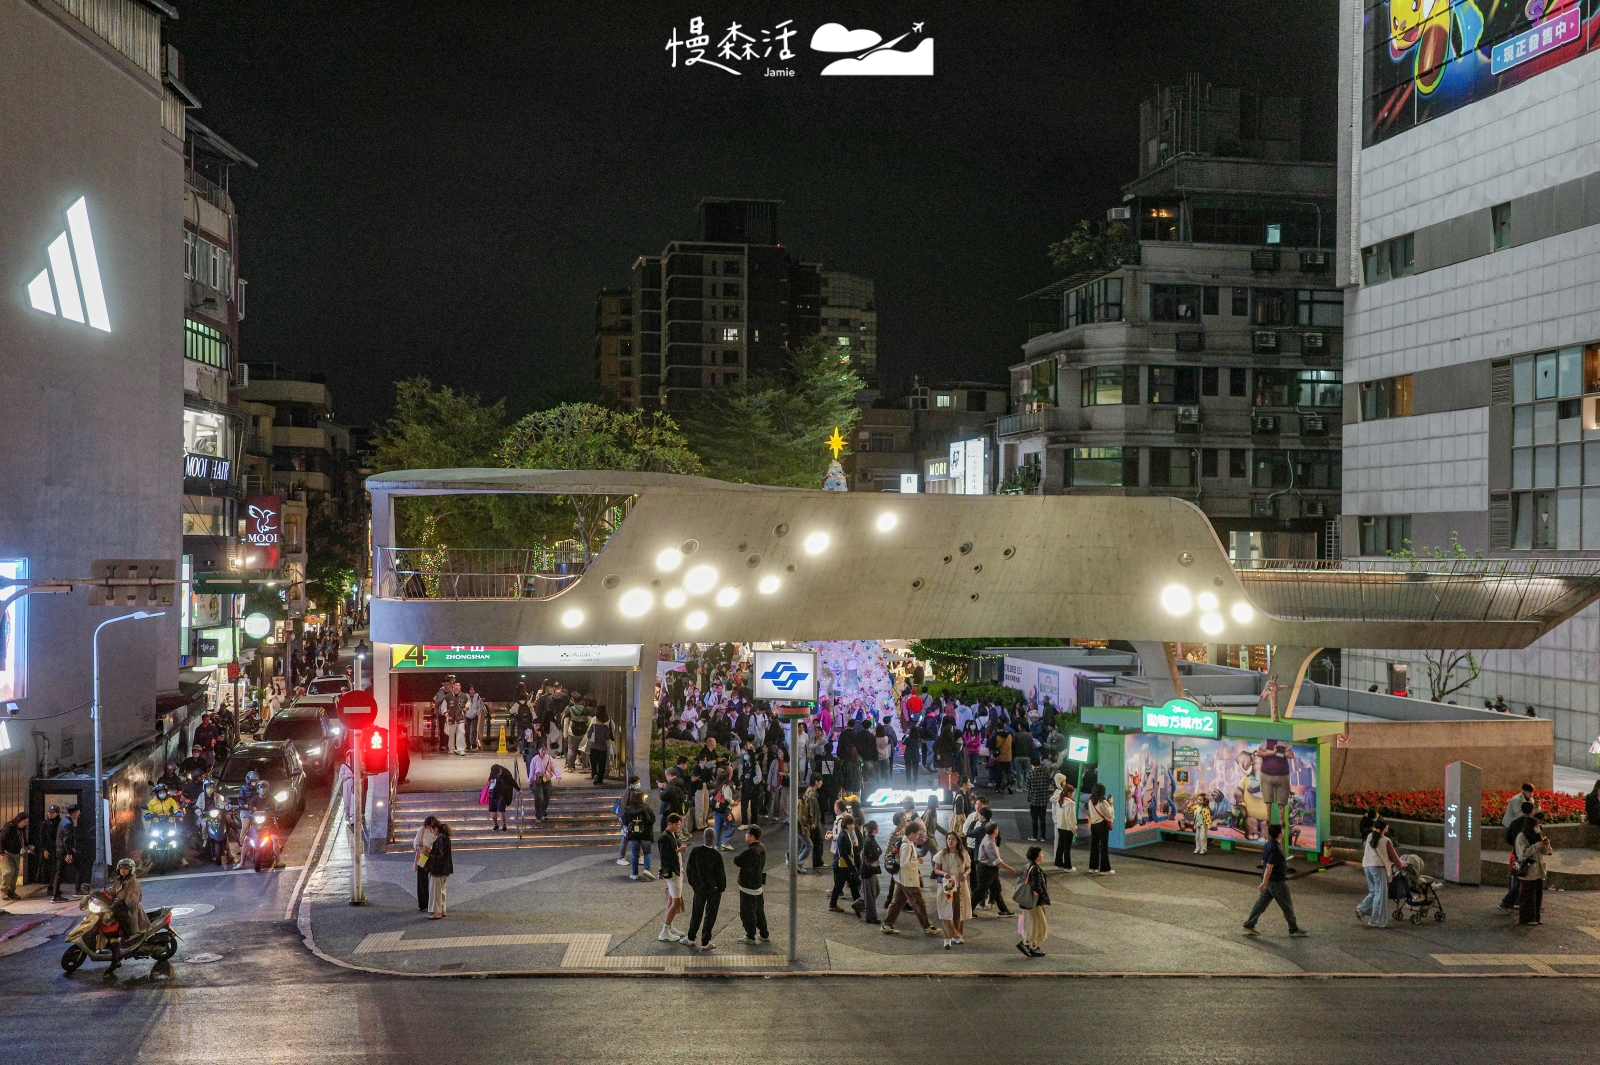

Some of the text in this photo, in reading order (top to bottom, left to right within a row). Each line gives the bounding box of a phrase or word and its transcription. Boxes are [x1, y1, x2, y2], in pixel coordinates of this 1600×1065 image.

[1503, 26, 1566, 62] 現正發售中
[185, 456, 231, 480] MOOI HAIR
[929, 462, 947, 476] MORI
[248, 533, 278, 543] MOOI
[404, 645, 428, 667] 4
[1171, 705, 1189, 715] Disney
[1146, 713, 1214, 732] 動物方城市2
[1447, 804, 1458, 837] 心中山
